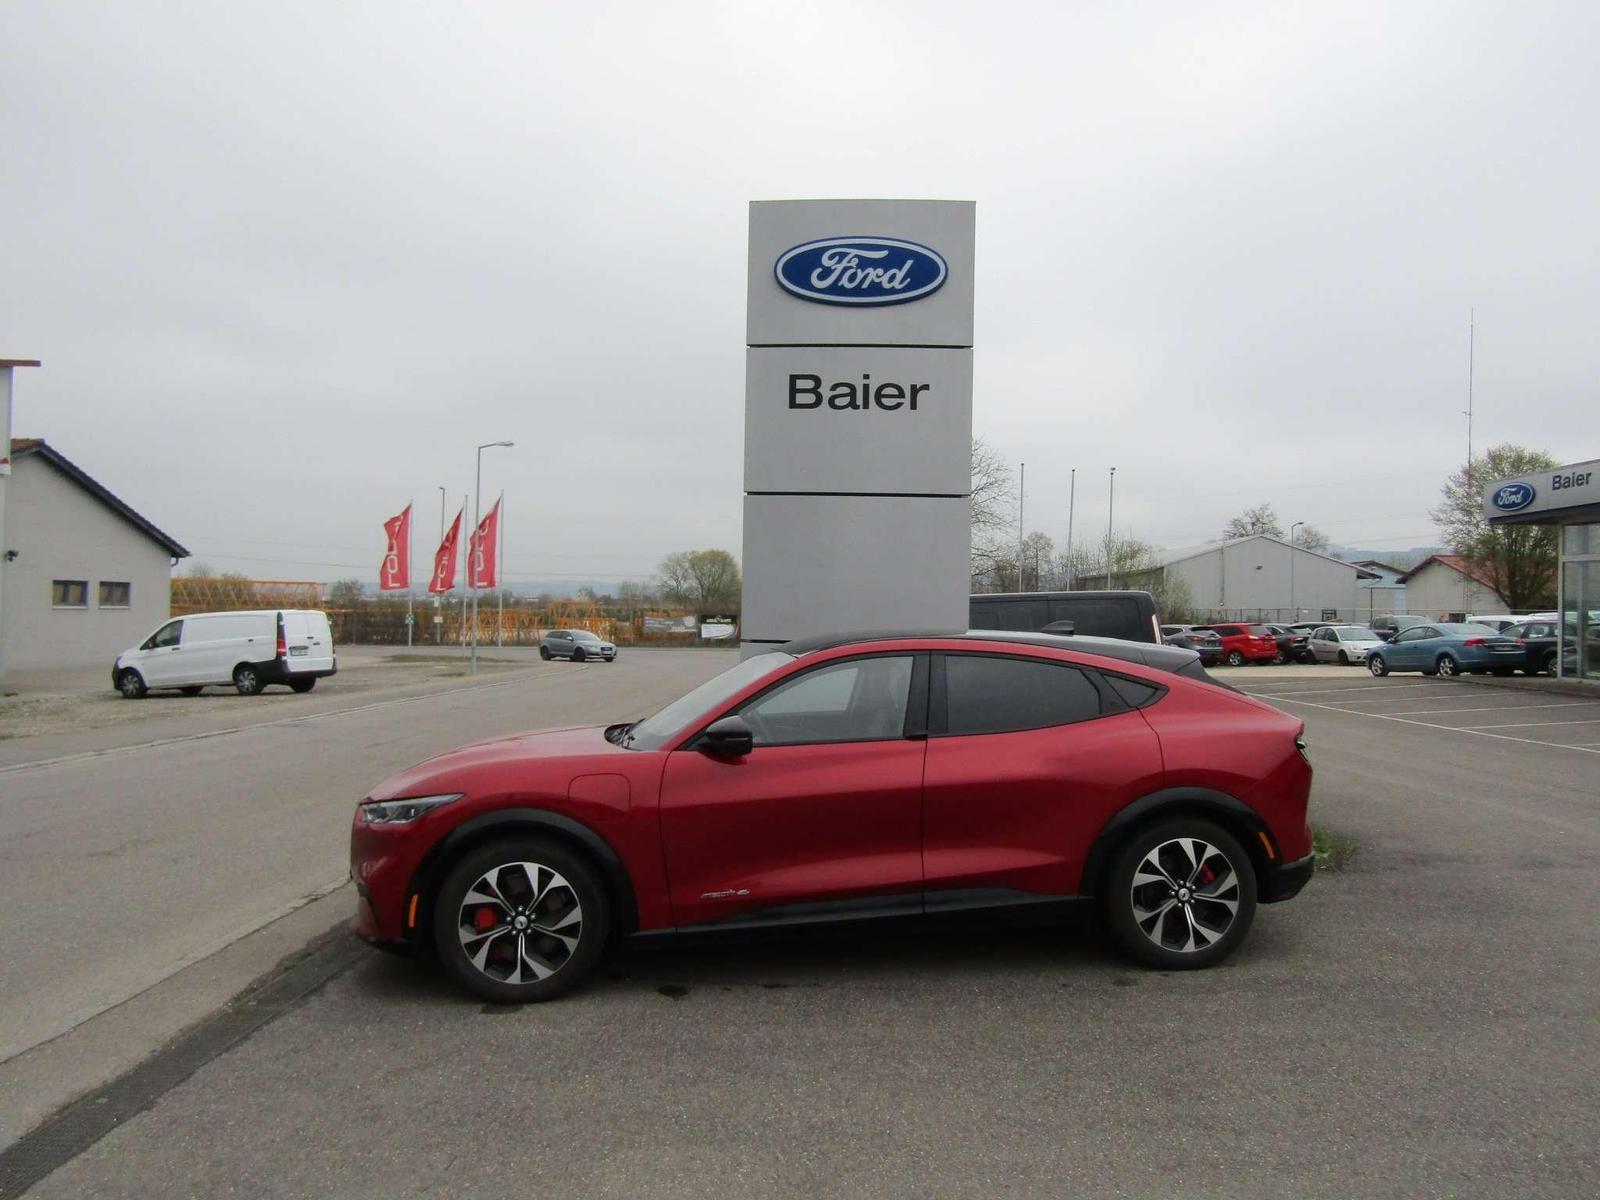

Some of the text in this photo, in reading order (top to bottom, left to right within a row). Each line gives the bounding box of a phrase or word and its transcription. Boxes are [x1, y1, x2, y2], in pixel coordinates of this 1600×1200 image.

[810, 247, 914, 290] Ford
[788, 373, 930, 411] Baier
[1498, 472, 1592, 505] Ford Baier
